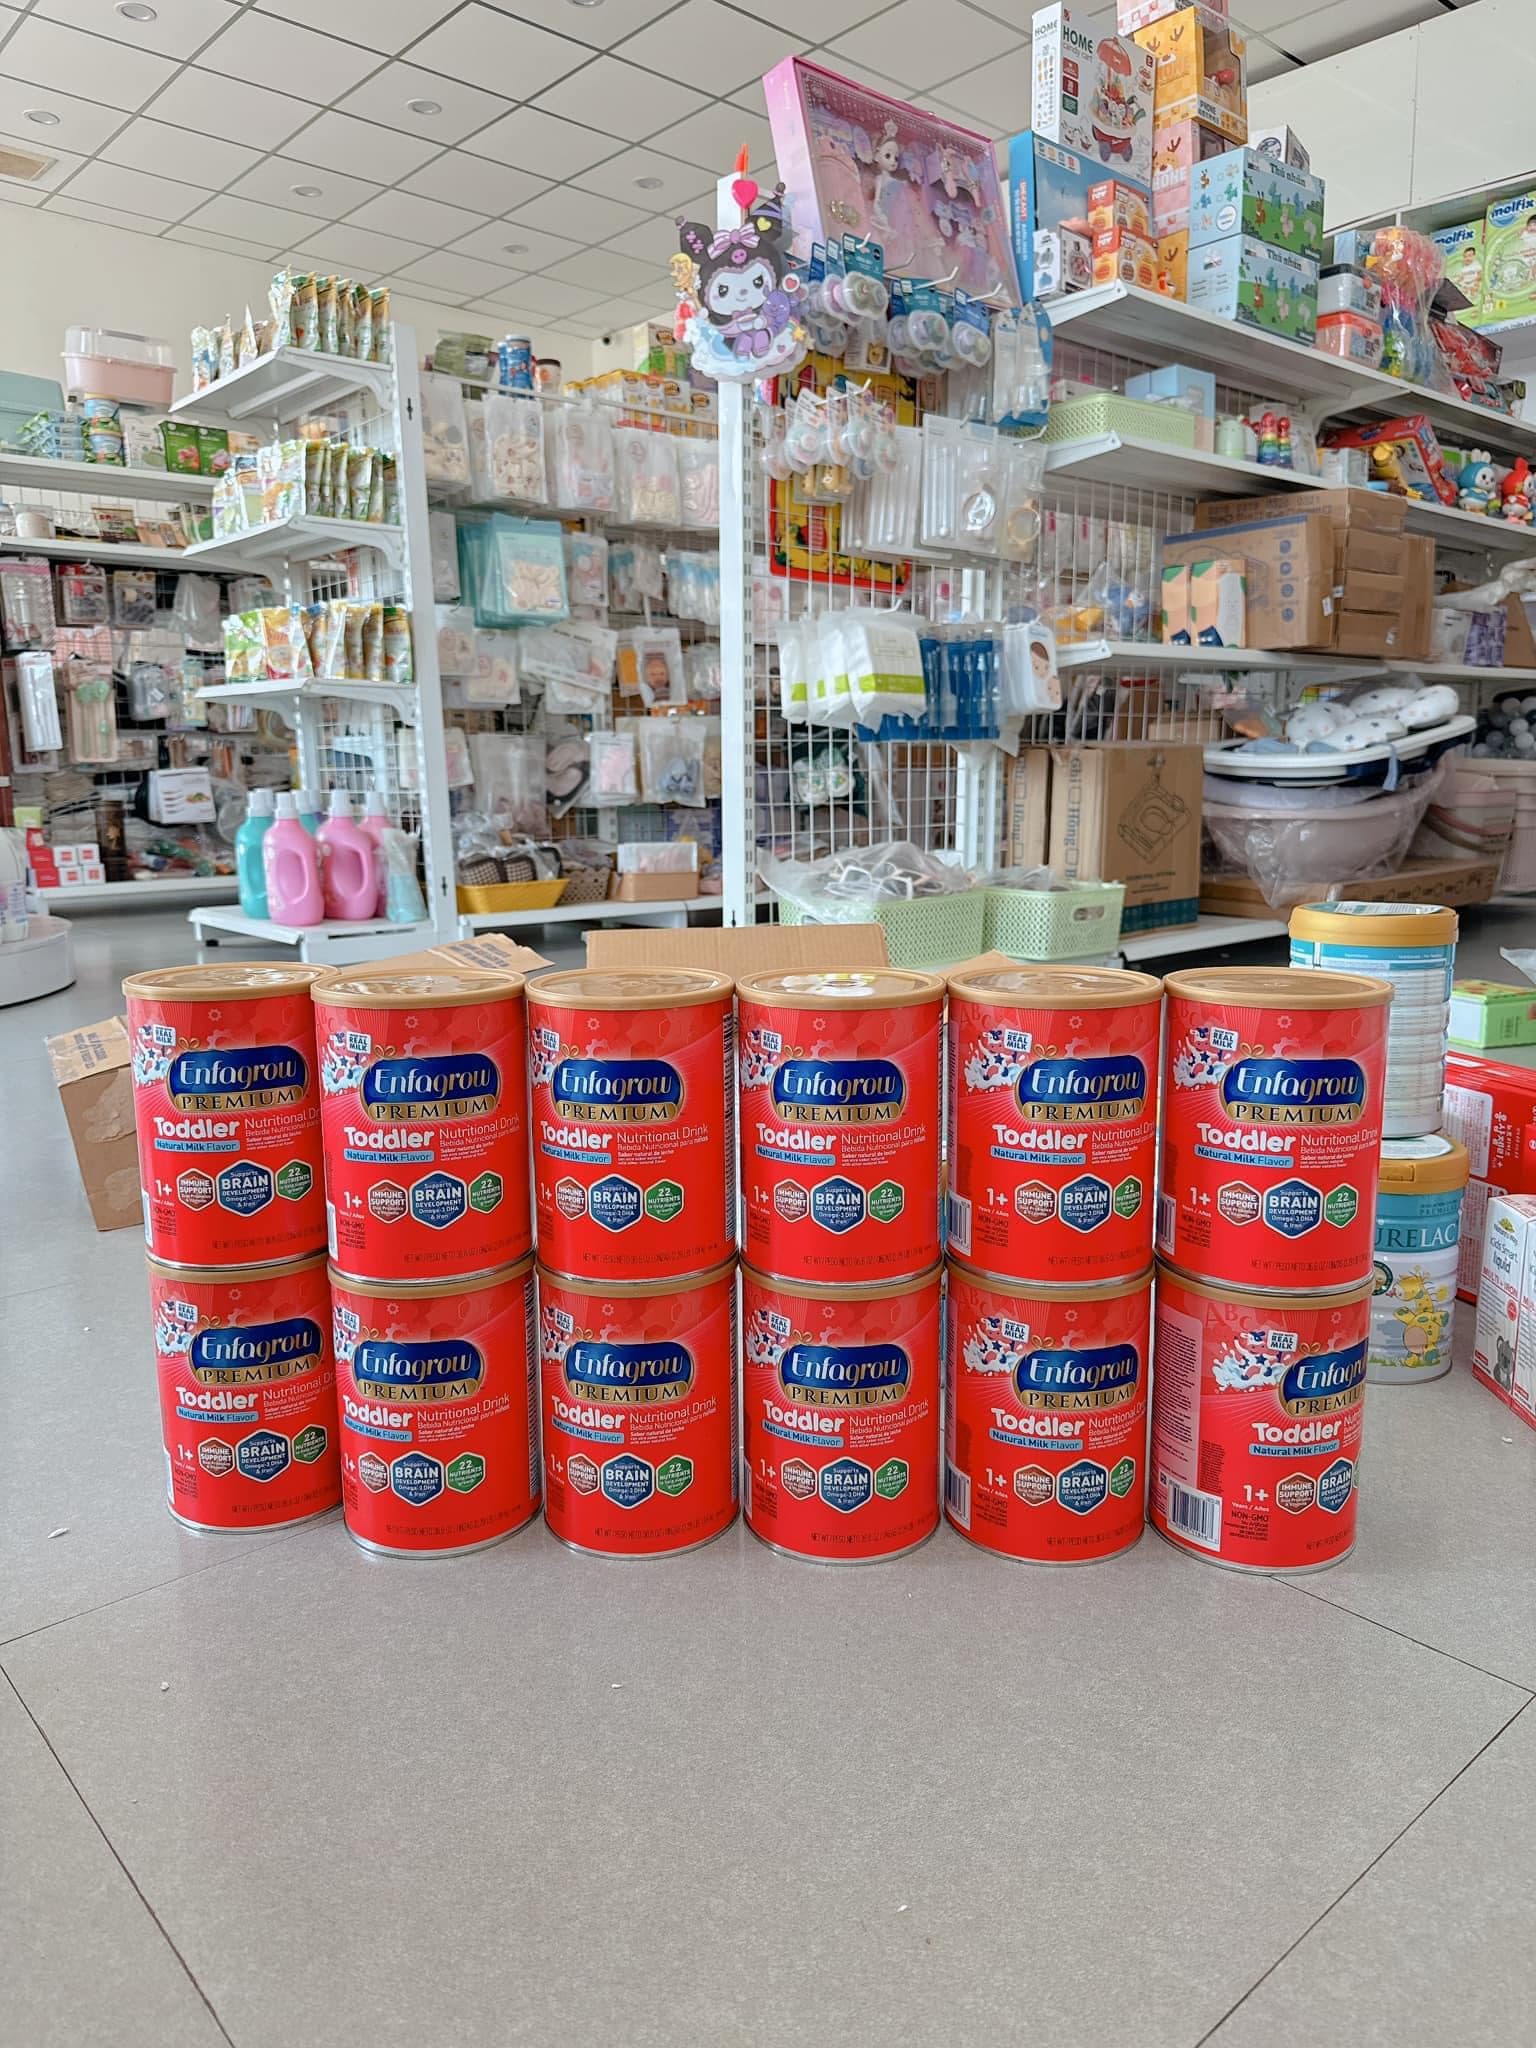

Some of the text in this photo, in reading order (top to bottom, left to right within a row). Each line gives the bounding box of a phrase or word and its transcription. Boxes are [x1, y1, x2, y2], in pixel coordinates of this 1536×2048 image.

[1063, 25, 1093, 54] HOME
[1491, 198, 1536, 217] molfix
[1435, 229, 1474, 245] molfix
[180, 1059, 297, 1089] Enfagrow
[375, 1068, 490, 1099] Enfagrow
[561, 1067, 672, 1102] Enfagrow
[784, 1069, 896, 1103] Enfagrow
[1032, 1069, 1140, 1099] Enfagrow
[1238, 1067, 1358, 1103] Enfagrow
[182, 1089, 294, 1109] PREMIUM
[376, 1099, 488, 1119] PREMIUM
[562, 1103, 668, 1121] PREMIUM
[784, 1105, 892, 1121] PREMIUM
[1032, 1104, 1136, 1120] PREMIUM
[1236, 1107, 1353, 1122] PREMIUM
[244, 1109, 303, 1128] Nutritional
[153, 1117, 240, 1139] Toddler
[439, 1121, 498, 1139] Nutritional
[541, 1121, 613, 1150] Toddler
[617, 1125, 708, 1144] Nutritional Drink
[756, 1123, 836, 1150] Toddler
[841, 1125, 926, 1144] Nutritional Drink
[1092, 1127, 1142, 1141] Nutritional
[156, 1141, 236, 1151] Natural Milk Flavor
[344, 1127, 435, 1149] Toddler
[993, 1125, 1088, 1150] Toddler
[1197, 1123, 1296, 1152] Toddler
[1301, 1134, 1359, 1147] Nutritional
[347, 1151, 430, 1162] Natural Milk Flavor
[564, 1150, 608, 1163] Milk Flavor
[758, 1147, 832, 1164] Natural Milk Flavor
[994, 1147, 1082, 1164] Natural Milk Flavor
[1198, 1147, 1289, 1166] Natural Milk Flavor
[288, 1168, 300, 1176] 22
[222, 1176, 268, 1189] BRAIN
[481, 1179, 492, 1188] 22
[372, 1191, 403, 1199] IMMUNE
[416, 1187, 461, 1201] BRAIN
[557, 1193, 584, 1203] SUPPORT
[594, 1191, 638, 1203] BRAIN
[658, 1188, 670, 1196] 22
[778, 1189, 805, 1199] IMMUNE
[816, 1193, 861, 1205] BRAIN
[880, 1189, 892, 1198] 22
[1019, 1190, 1052, 1200] IMMUNE
[1064, 1191, 1108, 1204] BRAIN
[1223, 1191, 1256, 1202] IMMUNE
[1337, 1192, 1348, 1202] 22
[776, 1196, 806, 1206] SUPPORT
[1018, 1198, 1055, 1208] SUPPORT
[1221, 1199, 1259, 1209] SUPPORT
[1270, 1196, 1318, 1208] BRAIN
[1375, 1223, 1456, 1248] URELAC
[1493, 1251, 1511, 1273] liquid
[202, 1330, 312, 1363] Enfagrow
[204, 1359, 310, 1382] PREMIUM
[362, 1348, 472, 1382] Enfagrow
[575, 1349, 683, 1384] Enfagrow
[792, 1352, 901, 1387] Enfagrow
[1030, 1358, 1134, 1389] Enfagrow
[1297, 1359, 1363, 1390] Enfagr
[263, 1379, 321, 1400] Nutritional
[363, 1382, 468, 1399] PREMIUM
[576, 1386, 679, 1402] PREMIUM
[792, 1387, 897, 1404] PREMIUM
[1295, 1383, 1364, 1413] PREMIU
[176, 1387, 258, 1410] Toddler
[1029, 1389, 1131, 1408] PREMIUM
[179, 1408, 255, 1422] Natural Milk Flavor
[343, 1395, 413, 1427] Toddler
[418, 1404, 480, 1421] Nutritional
[552, 1395, 625, 1429] Toddler
[630, 1407, 690, 1424] Nutritional
[763, 1399, 845, 1433] Toddler
[850, 1408, 907, 1427] Nutritional
[1089, 1410, 1137, 1428] Nutritional
[991, 1408, 1085, 1436] Toddler
[366, 1426, 409, 1440] Milk Flavor
[576, 1428, 620, 1442] Milk Flavor
[764, 1422, 840, 1446] Natural Milk Flavor
[993, 1431, 1079, 1449] Natural Milk Flavor
[1251, 1421, 1342, 1444] Toddler
[202, 1447, 230, 1455] IMMUNE
[241, 1442, 286, 1458] BRAIN
[1253, 1445, 1290, 1455] Natural
[1313, 1442, 1336, 1454] Flavor
[395, 1467, 439, 1478] BRAIN
[570, 1469, 597, 1480] SUPPORT
[606, 1470, 649, 1480] BRAIN
[784, 1473, 815, 1485] SUPPORT
[824, 1473, 868, 1485] BRAIN
[1322, 1470, 1351, 1489] BRAIN
[1016, 1480, 1052, 1490] SUPPORT
[1062, 1476, 1104, 1488] BRAIN
[1244, 1485, 1269, 1502] 1+
[1279, 1489, 1313, 1497] SUPPORT
